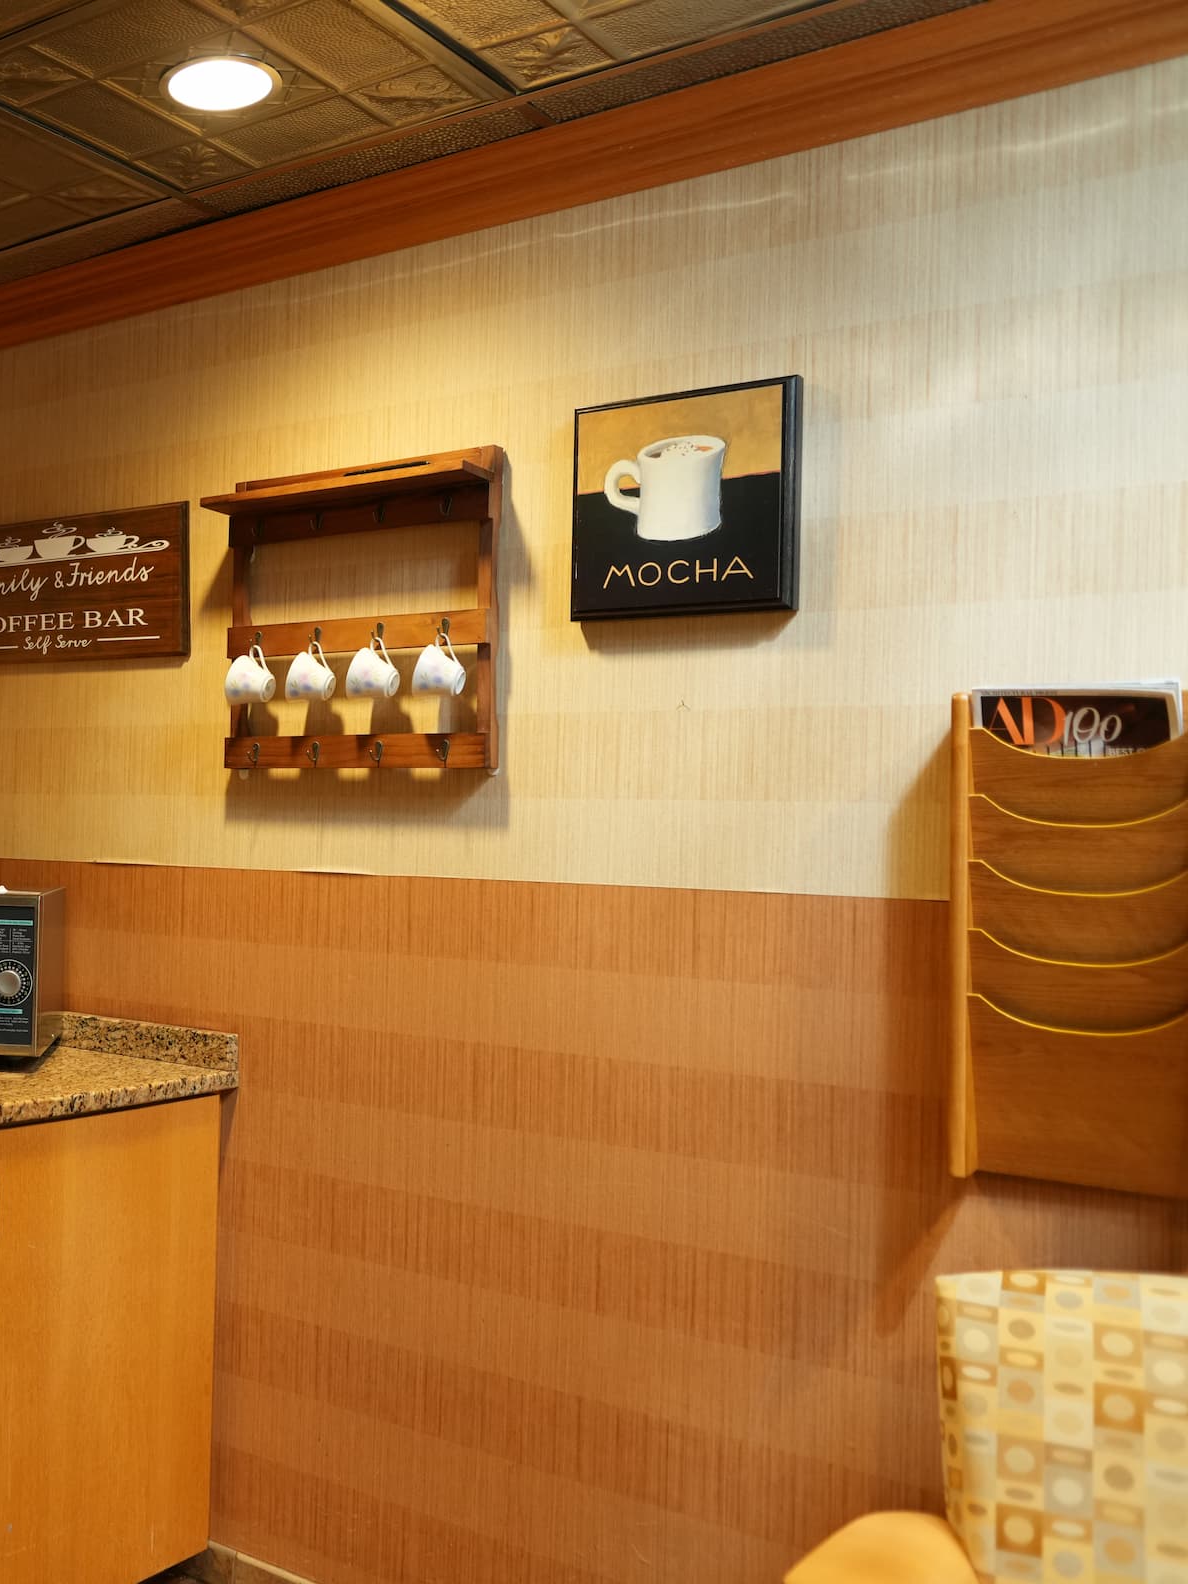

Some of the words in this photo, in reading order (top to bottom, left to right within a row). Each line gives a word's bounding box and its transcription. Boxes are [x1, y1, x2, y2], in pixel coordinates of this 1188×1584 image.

[54, 571, 64, 588] &
[66, 556, 154, 587] Friends
[603, 556, 754, 589] MOCHA
[83, 608, 148, 629] BAR
[23, 635, 53, 655] Self
[55, 634, 92, 649] Serve
